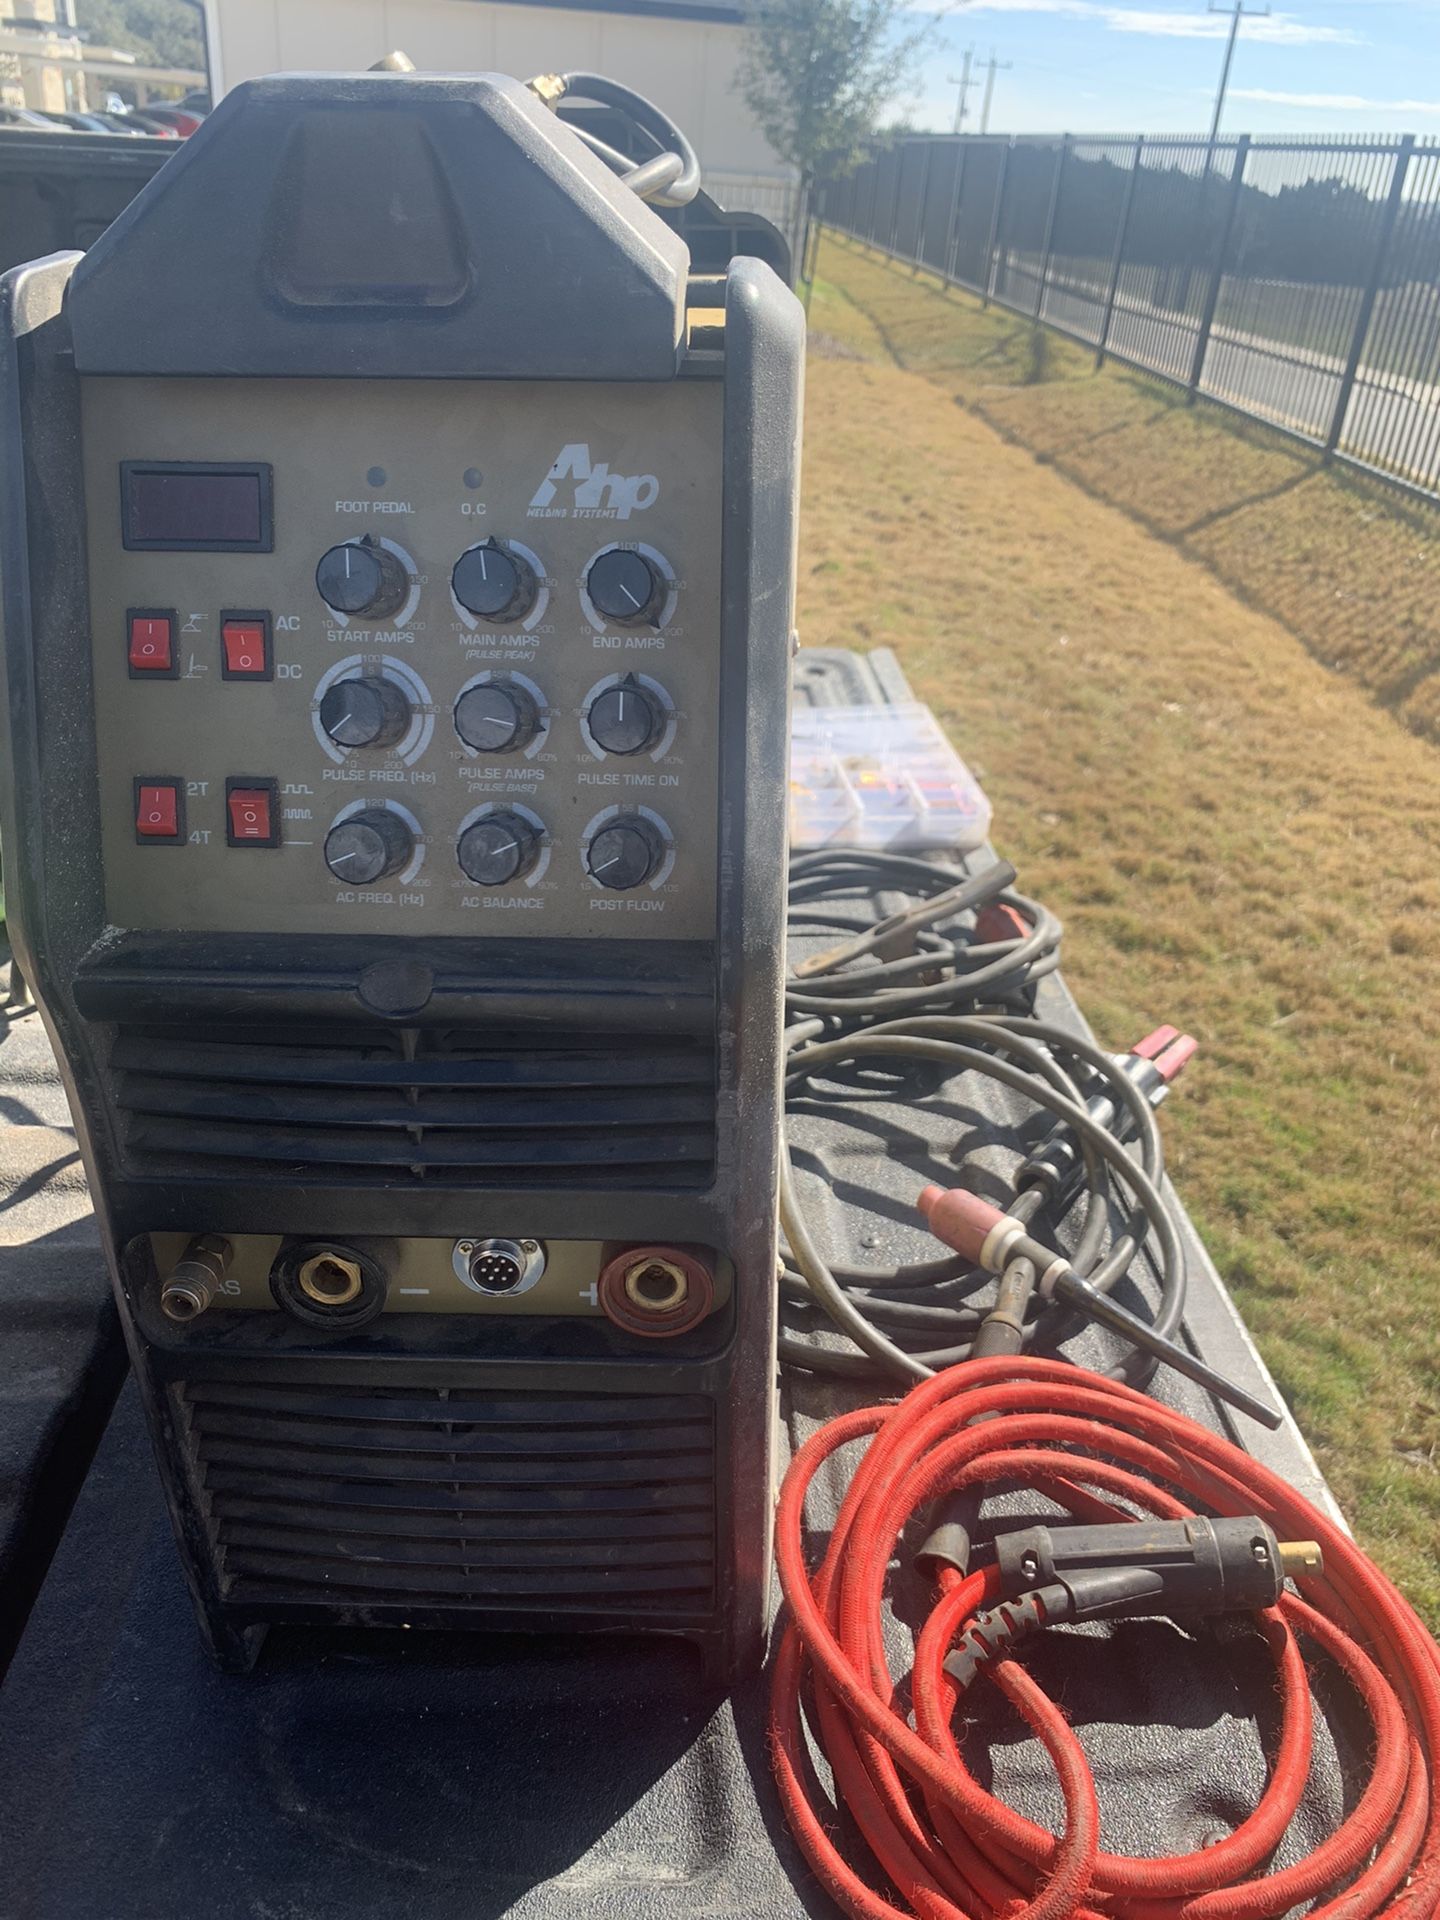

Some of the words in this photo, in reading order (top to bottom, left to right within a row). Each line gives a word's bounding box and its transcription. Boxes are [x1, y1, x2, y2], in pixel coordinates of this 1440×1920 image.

[529, 443, 659, 520] Ahp
[335, 501, 370, 513] FOOT
[373, 501, 416, 514] PEDAL
[461, 503, 487, 515] O.C
[526, 507, 567, 519] WELDING
[571, 508, 616, 519] SYSTEMS
[275, 616, 301, 631] AC
[321, 620, 334, 629] 10
[450, 622, 463, 632] 10
[536, 624, 555, 634] 200
[579, 625, 591, 635] 10
[327, 630, 370, 642] START
[374, 631, 415, 643] AMPS
[458, 633, 496, 645] MAIN
[500, 634, 540, 647] AMPS
[592, 636, 620, 648] END
[624, 637, 665, 649] AMPS
[363, 655, 381, 663] 100
[465, 649, 503, 661] (PULSE
[504, 650, 536, 662] PEAK)
[276, 664, 303, 679] DC
[322, 769, 366, 781] PULSE
[369, 770, 408, 782] FREQ.
[411, 771, 436, 785] (Hz)
[458, 767, 502, 779] PULSE
[504, 768, 545, 780] AMPS
[578, 773, 620, 785] PULSE
[622, 774, 655, 786] TIME
[659, 775, 680, 787] ON
[187, 782, 209, 796] 2T
[189, 830, 212, 844] 4T
[335, 892, 355, 903] AC
[358, 893, 397, 904] FREQ.
[399, 893, 424, 907] (Hz)
[461, 896, 480, 908] AC
[483, 897, 545, 909] BALANCE
[590, 899, 624, 911] POST
[627, 900, 666, 912] FLOW
[216, 1279, 242, 1296] AS
